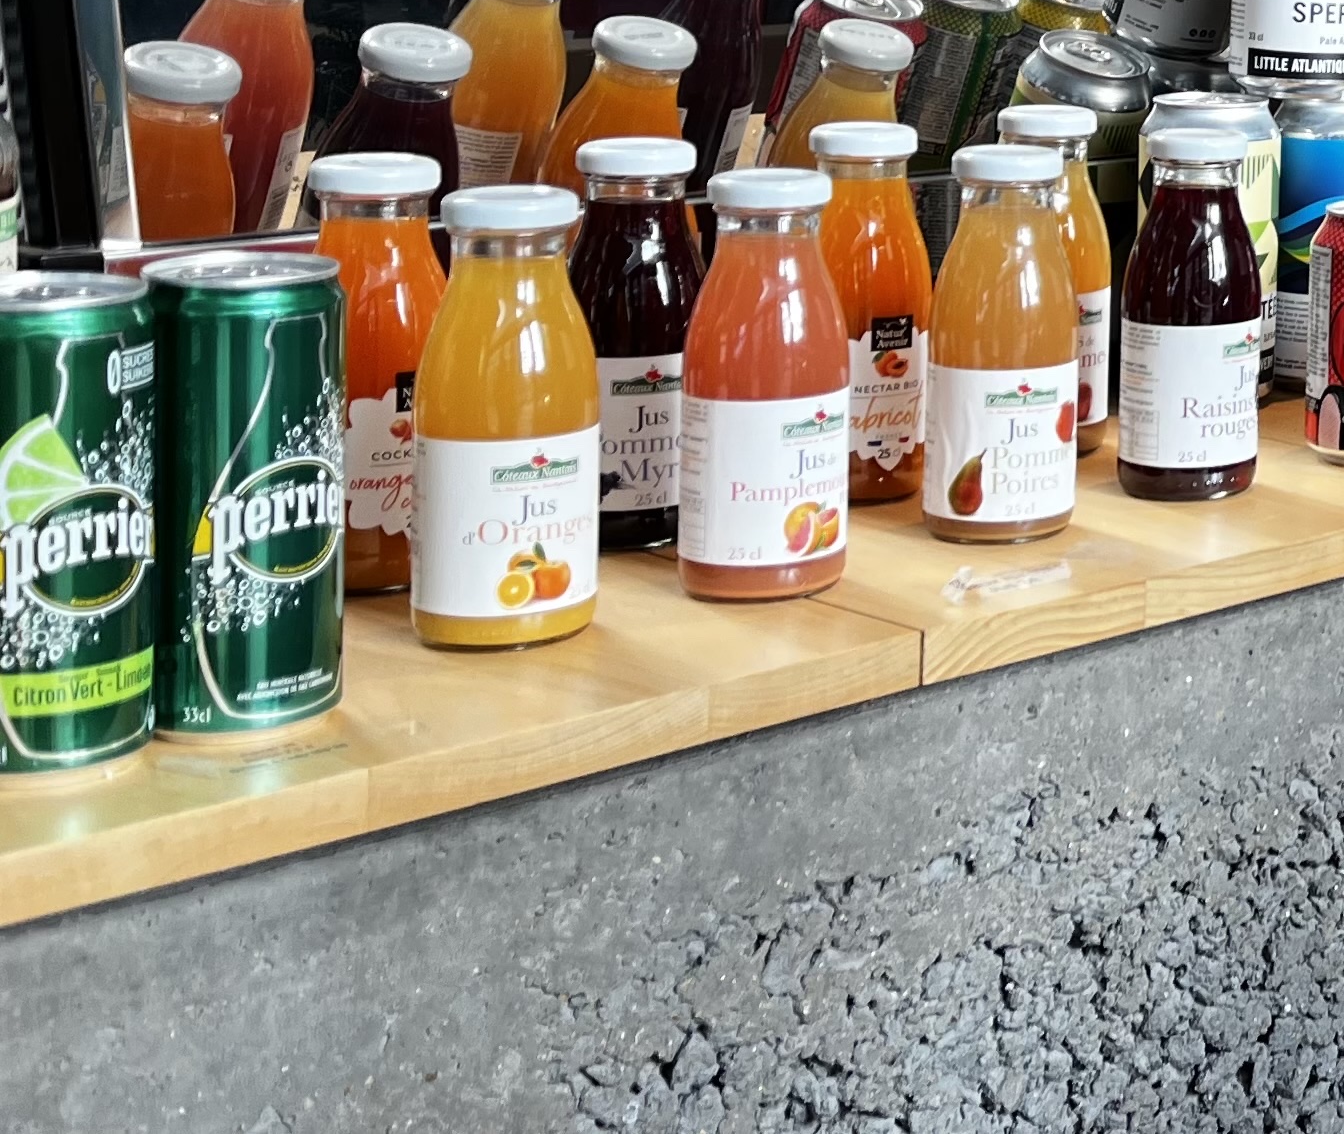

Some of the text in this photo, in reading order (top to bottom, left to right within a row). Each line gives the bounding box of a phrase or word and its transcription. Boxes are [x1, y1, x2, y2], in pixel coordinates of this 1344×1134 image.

[1319, 34, 1337, 45] Pale
[1254, 54, 1289, 72] LITTLE
[853, 379, 919, 394] NECTAR BIO
[849, 381, 924, 433] abricot
[628, 404, 670, 433] Jus
[1199, 414, 1258, 441] rouges
[1000, 416, 1039, 445] Jus
[789, 448, 827, 479] Jus
[878, 447, 891, 460] 25
[1177, 449, 1207, 464] 25 cl
[989, 471, 1059, 497] Poires
[512, 494, 557, 525] Jus
[634, 491, 667, 507] 25 cl
[1003, 504, 1022, 517] 25
[462, 513, 594, 546] d'Oranges
[727, 545, 762, 561] 25 cl
[13, 685, 67, 708] Citron
[69, 678, 104, 702] Vert
[182, 706, 212, 724] 33cl
